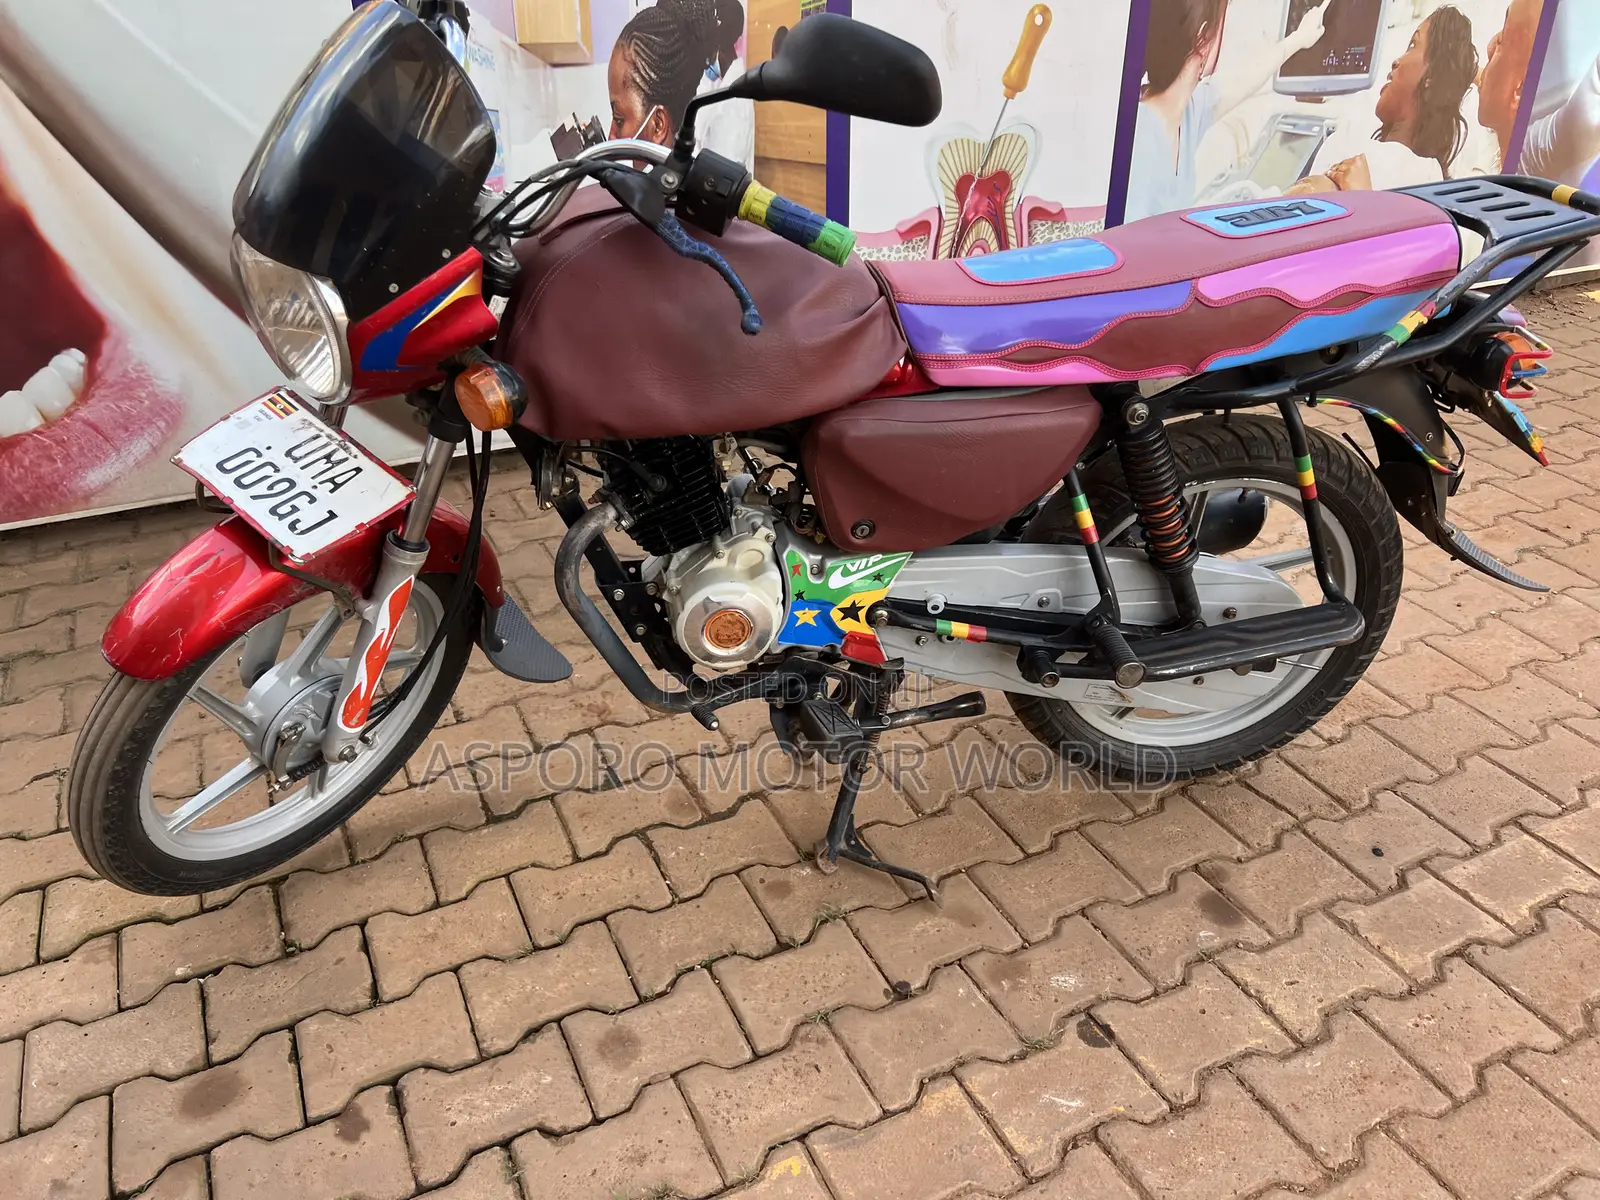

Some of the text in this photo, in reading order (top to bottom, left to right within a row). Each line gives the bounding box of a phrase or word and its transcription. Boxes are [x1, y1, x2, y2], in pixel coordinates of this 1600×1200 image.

[215, 446, 339, 537] 009GJ
[283, 433, 364, 494] UMA
[844, 553, 884, 574] VIP
